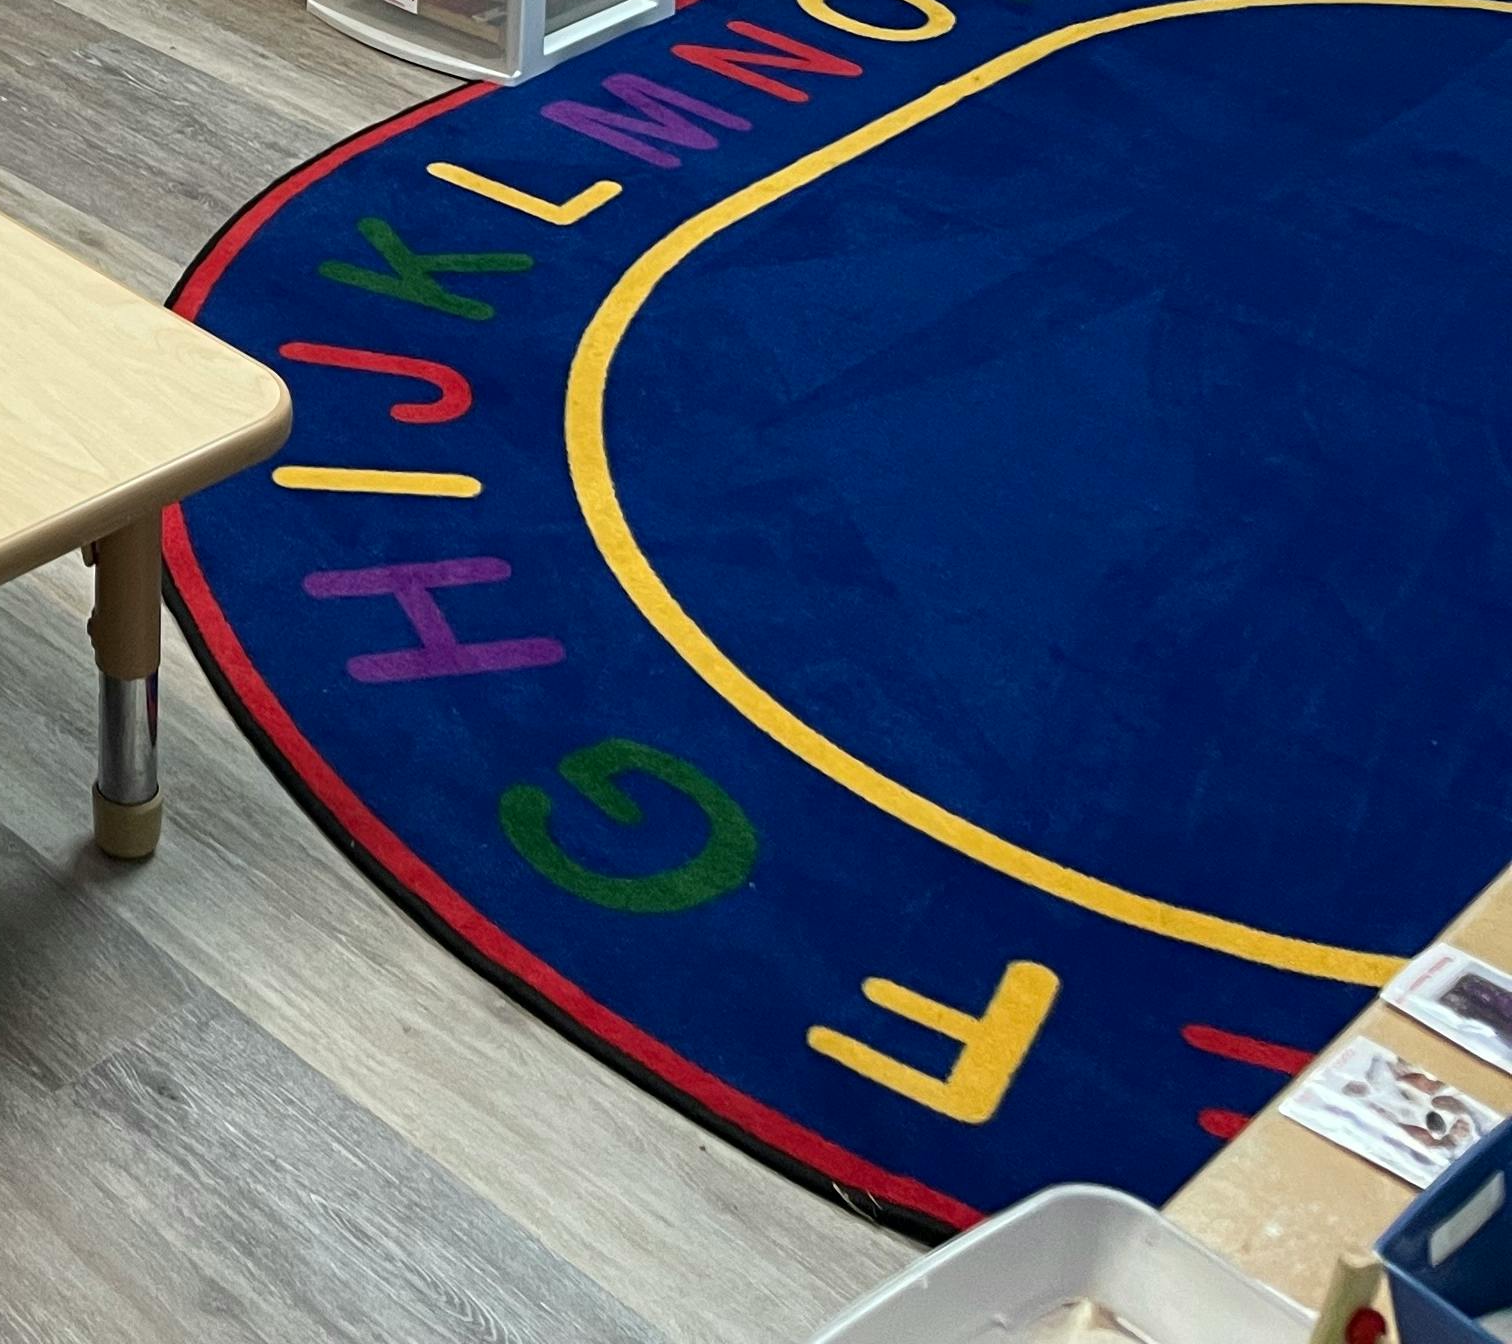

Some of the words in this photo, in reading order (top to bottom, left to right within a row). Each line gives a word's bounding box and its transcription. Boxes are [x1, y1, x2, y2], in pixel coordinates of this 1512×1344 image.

[671, 20, 864, 103] N
[539, 72, 753, 169] M
[426, 162, 623, 227] L
[318, 216, 535, 319] K
[278, 340, 474, 425] J
[302, 557, 567, 685] H
[500, 738, 760, 912] G
[806, 960, 1060, 1124] F
